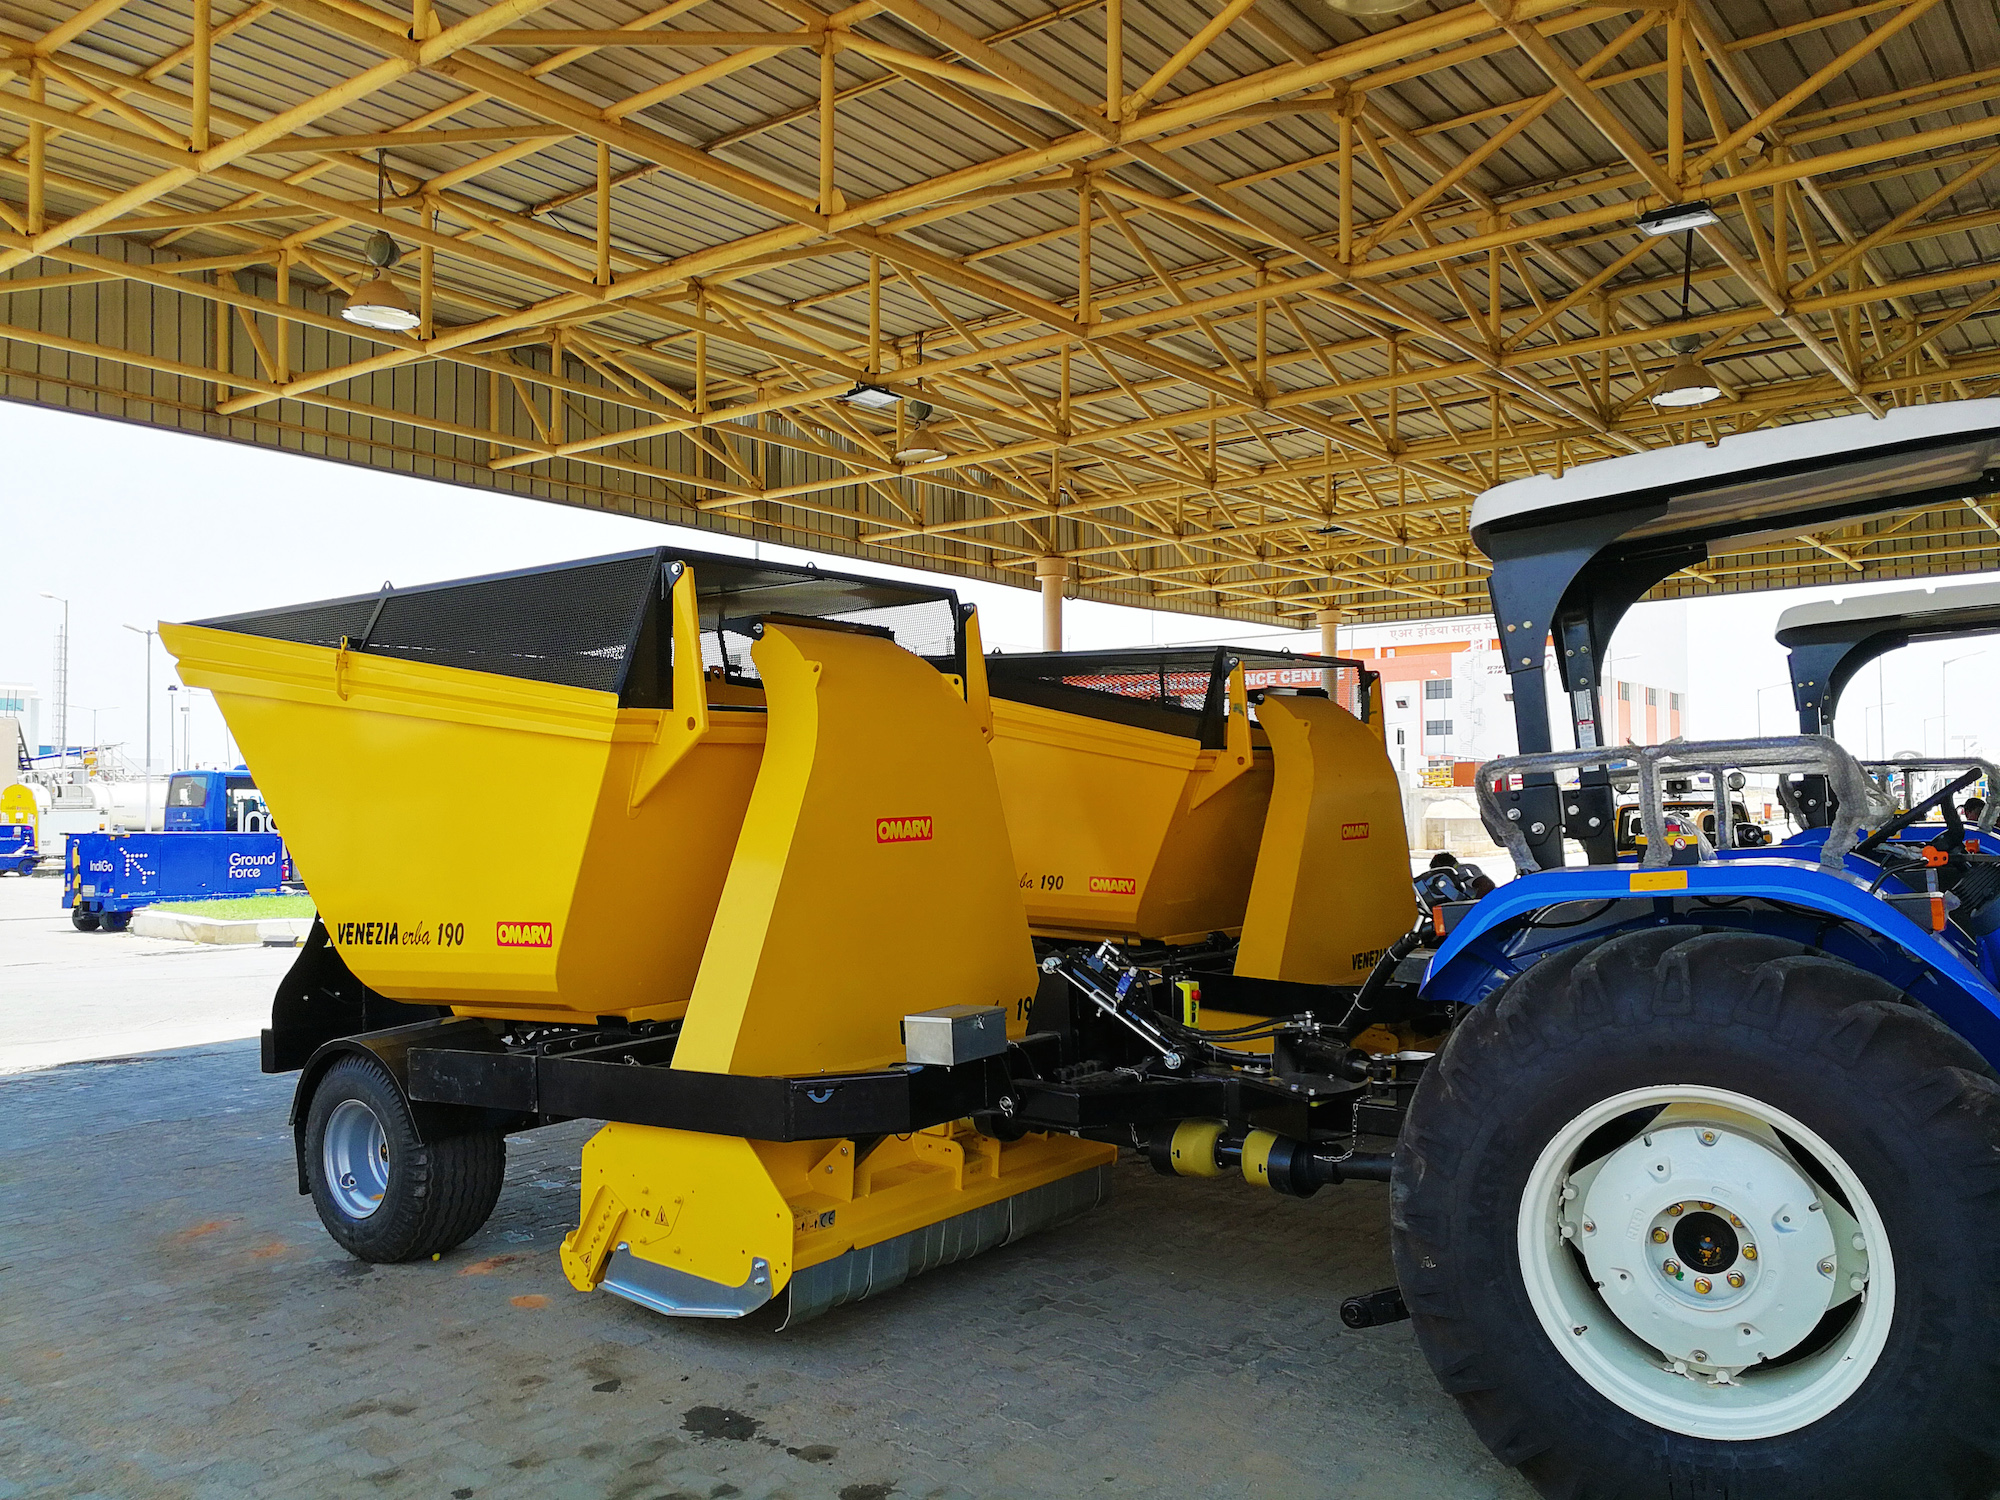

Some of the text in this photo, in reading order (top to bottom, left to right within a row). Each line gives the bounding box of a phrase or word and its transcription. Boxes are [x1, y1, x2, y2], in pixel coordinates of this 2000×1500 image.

[1280, 667, 1345, 684] CENTE
[878, 819, 931, 840] OMARV
[1342, 824, 1369, 839] OMARV
[89, 860, 114, 873] IndiGo
[228, 852, 276, 867] Ground
[228, 866, 262, 879] Force
[1019, 872, 1064, 891] ba 190
[1090, 878, 1134, 893] OMARV
[337, 920, 465, 947] VENEZIA erba 190
[497, 924, 552, 945] OMARV
[1016, 996, 1033, 1021] 19
